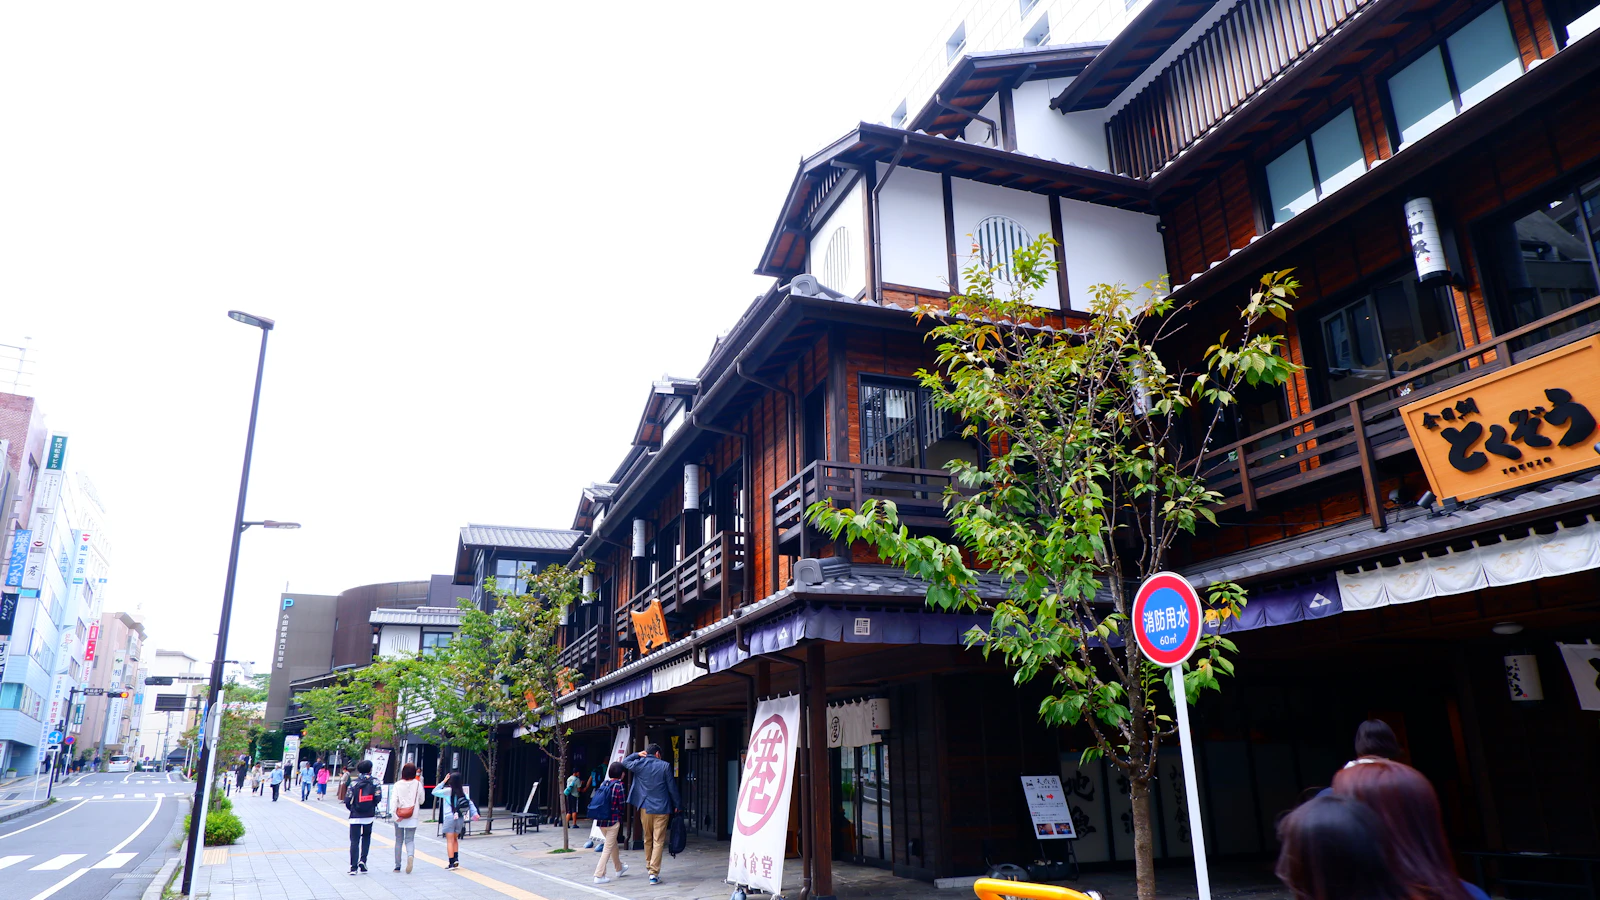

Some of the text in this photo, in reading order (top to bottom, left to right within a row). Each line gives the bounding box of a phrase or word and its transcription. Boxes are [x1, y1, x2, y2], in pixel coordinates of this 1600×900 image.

[1440, 388, 1597, 473] とくぞう
[1501, 457, 1552, 475] TOKUZO
[76, 544, 88, 574] 第一生命
[283, 598, 294, 611] P
[1143, 604, 1189, 634] 消防用水
